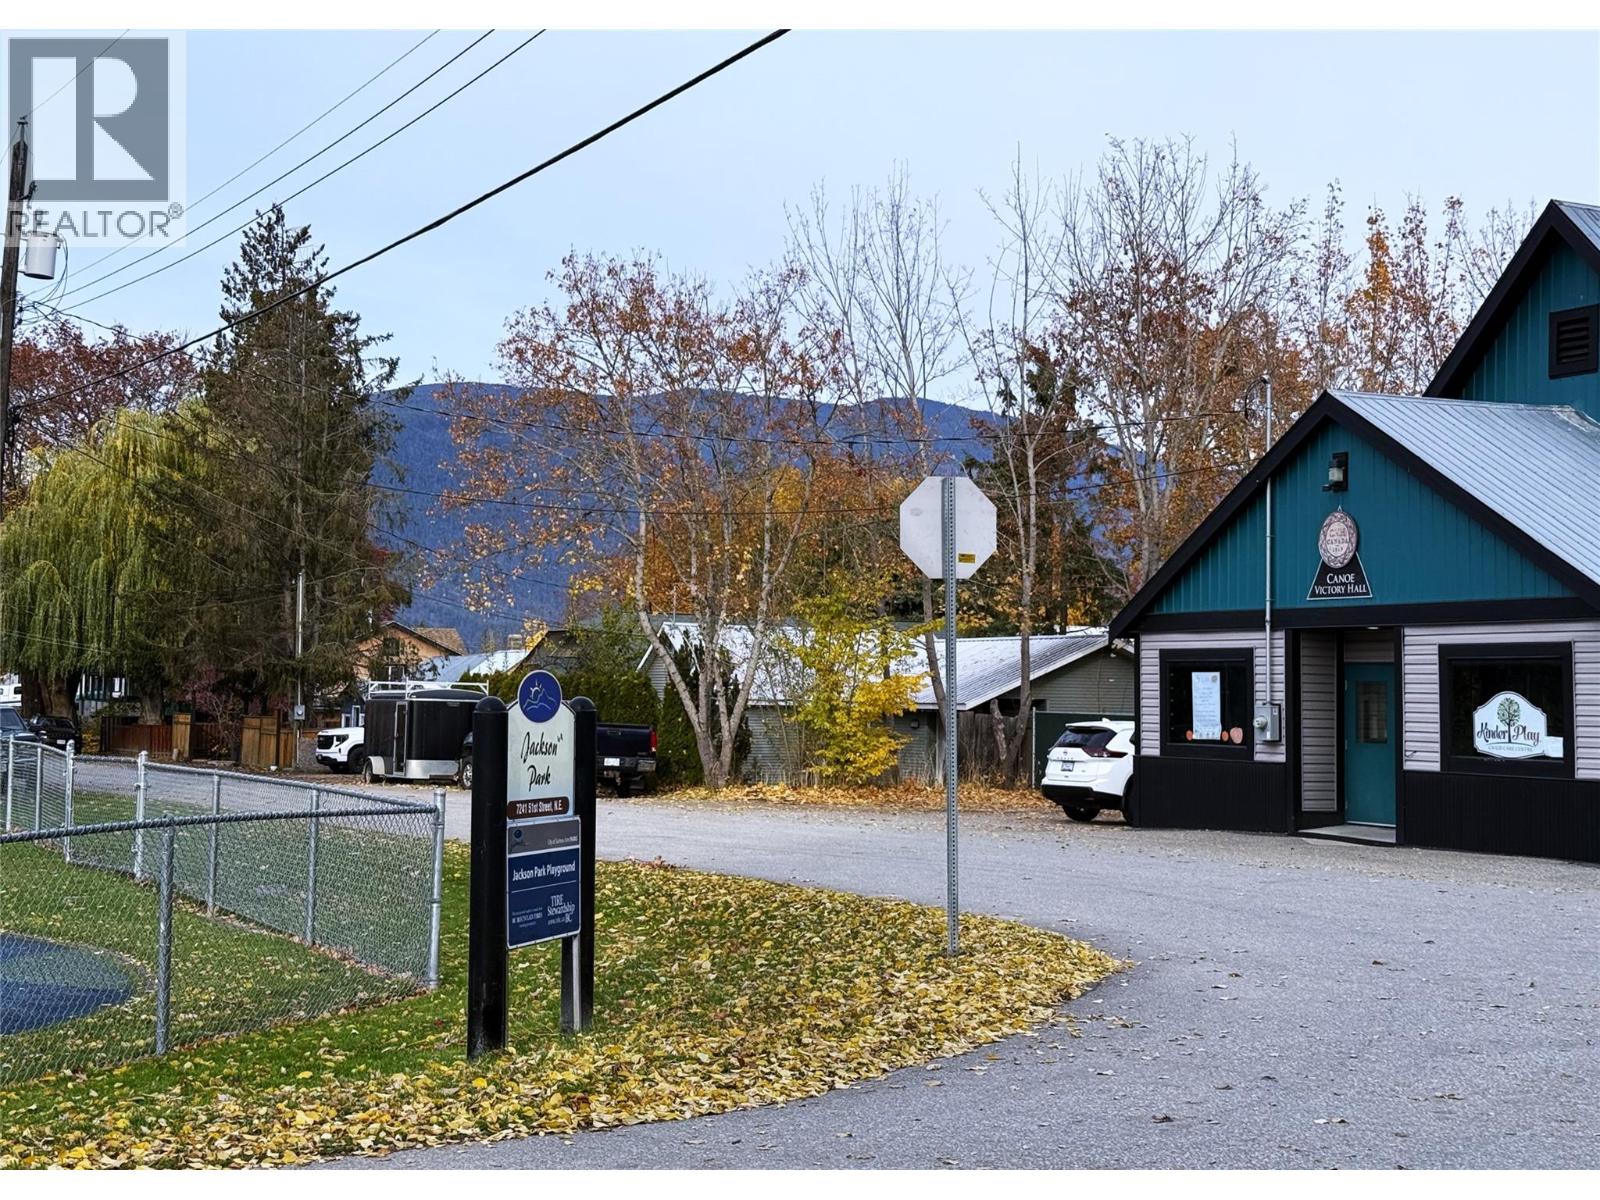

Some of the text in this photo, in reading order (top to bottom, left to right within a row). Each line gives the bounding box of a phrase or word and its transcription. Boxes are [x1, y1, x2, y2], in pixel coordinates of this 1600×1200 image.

[1327, 573, 1356, 584] CANOE
[1314, 583, 1368, 595] VICTORY HALL
[1477, 722, 1540, 747] Kinder Play
[520, 731, 558, 764] Jackson
[527, 764, 551, 792] Park
[512, 860, 576, 881] Jackson Park Playground
[547, 901, 576, 917] Stewardship
[550, 894, 564, 907] TIRE
